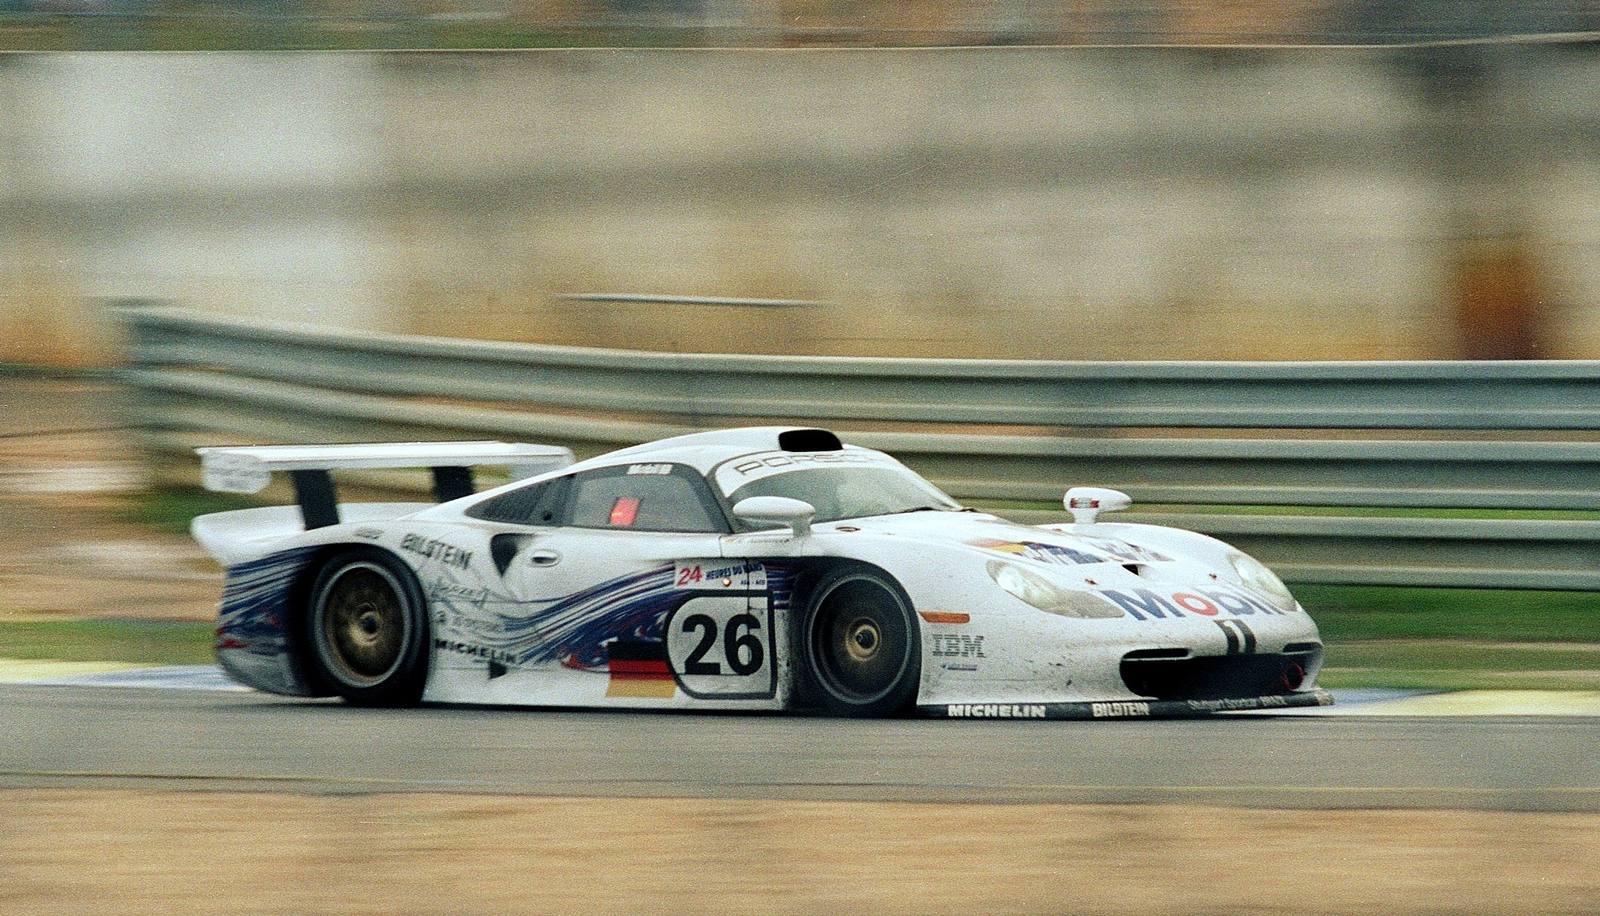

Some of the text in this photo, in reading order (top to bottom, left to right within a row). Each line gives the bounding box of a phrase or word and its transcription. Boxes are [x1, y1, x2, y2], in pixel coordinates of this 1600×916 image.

[734, 454, 873, 476] PORSC
[401, 533, 473, 570] BILSTEIN
[678, 565, 703, 586] 24
[1099, 584, 1287, 621] Mobil
[434, 638, 517, 660] MICHELIN
[682, 613, 765, 676] 26
[932, 634, 985, 659] IBM
[948, 702, 1150, 718] MICHELIN BILSTEIN
